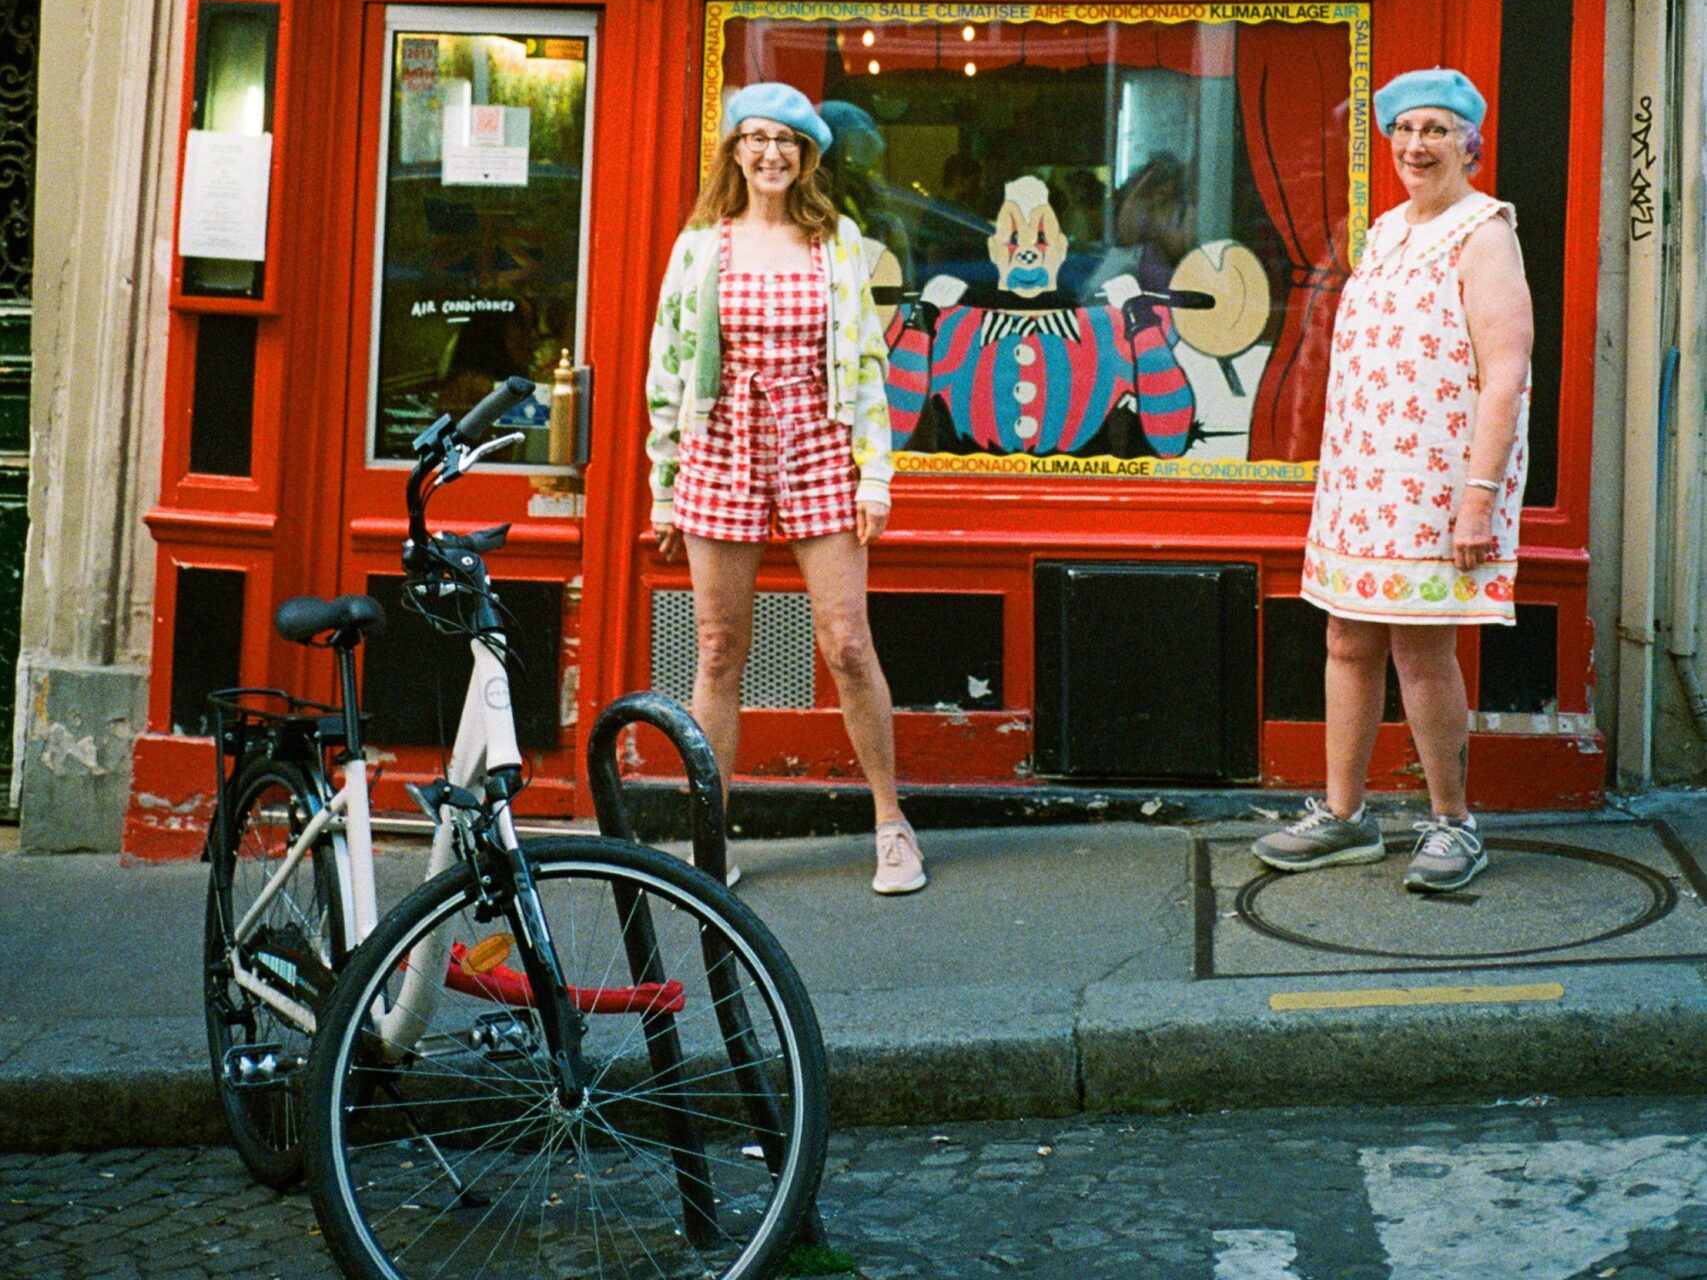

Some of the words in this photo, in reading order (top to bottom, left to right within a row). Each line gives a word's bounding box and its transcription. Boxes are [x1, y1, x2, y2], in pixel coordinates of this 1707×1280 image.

[731, 1, 876, 17] AIR-CONDITIONED
[879, 3, 928, 17] SALLE
[1034, 4, 1072, 18] AIRE
[1075, 4, 1205, 19] CONDICIONADO
[1210, 4, 1329, 19] KLIMAANLAGE
[1333, 4, 1359, 18] AIR
[1354, 20, 1369, 71] SALLE
[704, 4, 722, 133] CONDICIONADO
[411, 300, 436, 317] AIR
[898, 457, 1026, 473] CONDICIONADO
[1030, 461, 1149, 476] KLIMAANLAGE
[1153, 463, 1305, 478] AIR-CONDITIONED
